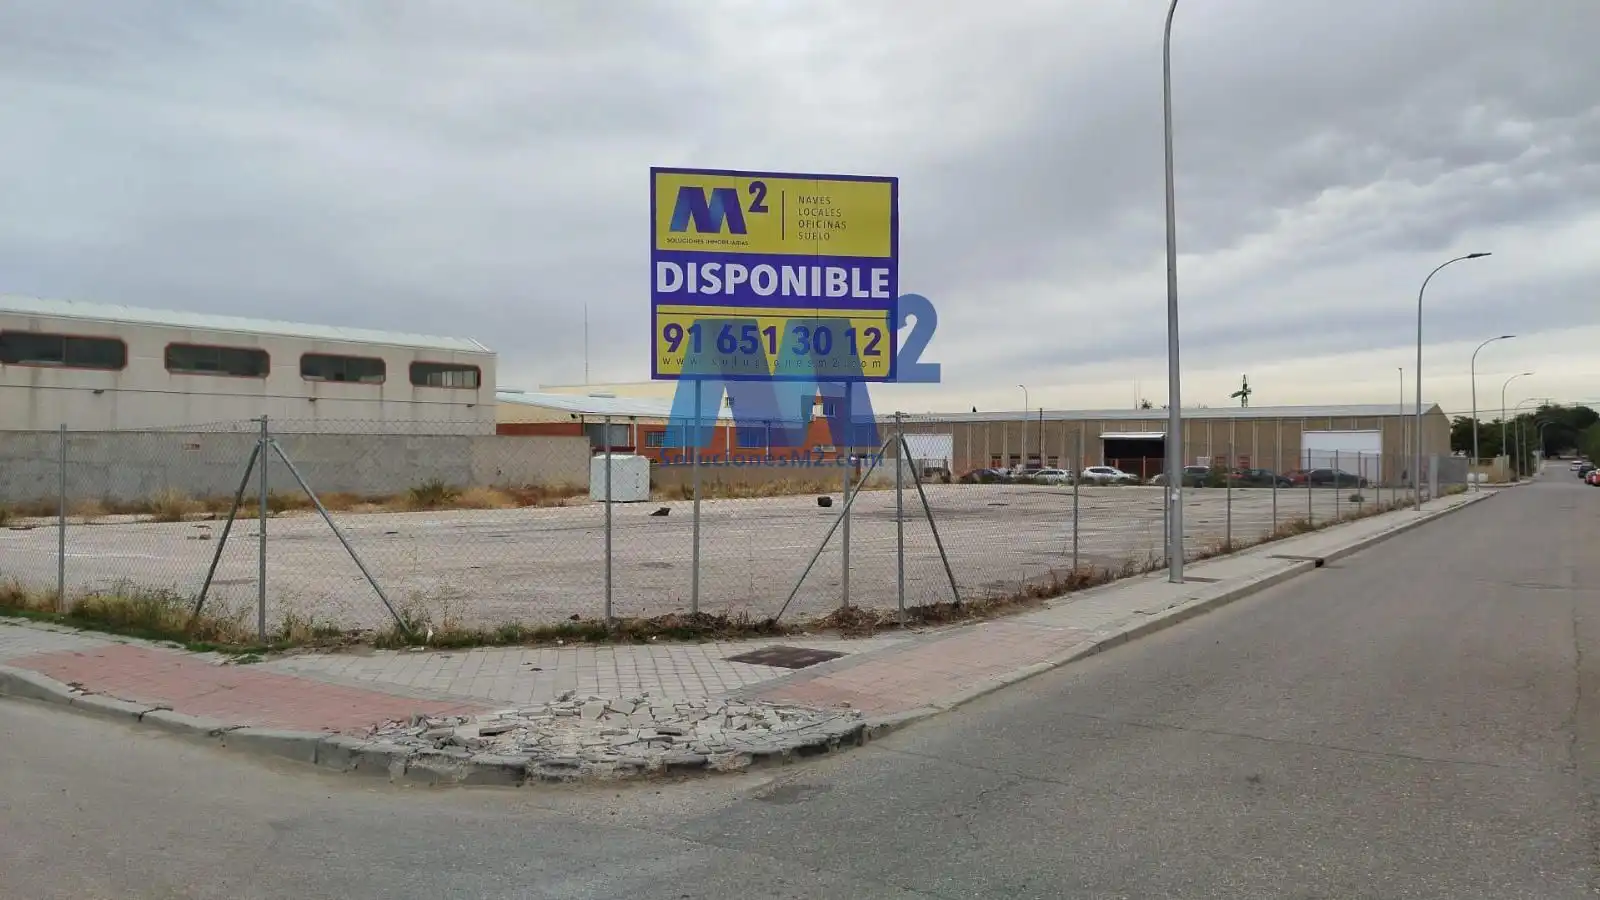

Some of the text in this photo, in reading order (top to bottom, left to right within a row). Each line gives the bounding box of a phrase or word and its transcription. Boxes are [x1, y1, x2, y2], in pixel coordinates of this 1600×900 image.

[798, 196, 831, 205] NAVES
[798, 208, 842, 217] LOCALES
[798, 219, 847, 230] OFICINAS
[666, 237, 704, 245] SOLUCIONES
[798, 231, 830, 241] SUELO
[656, 261, 890, 299] DISPONIBLE
[662, 323, 882, 357] 91 651 30 12
